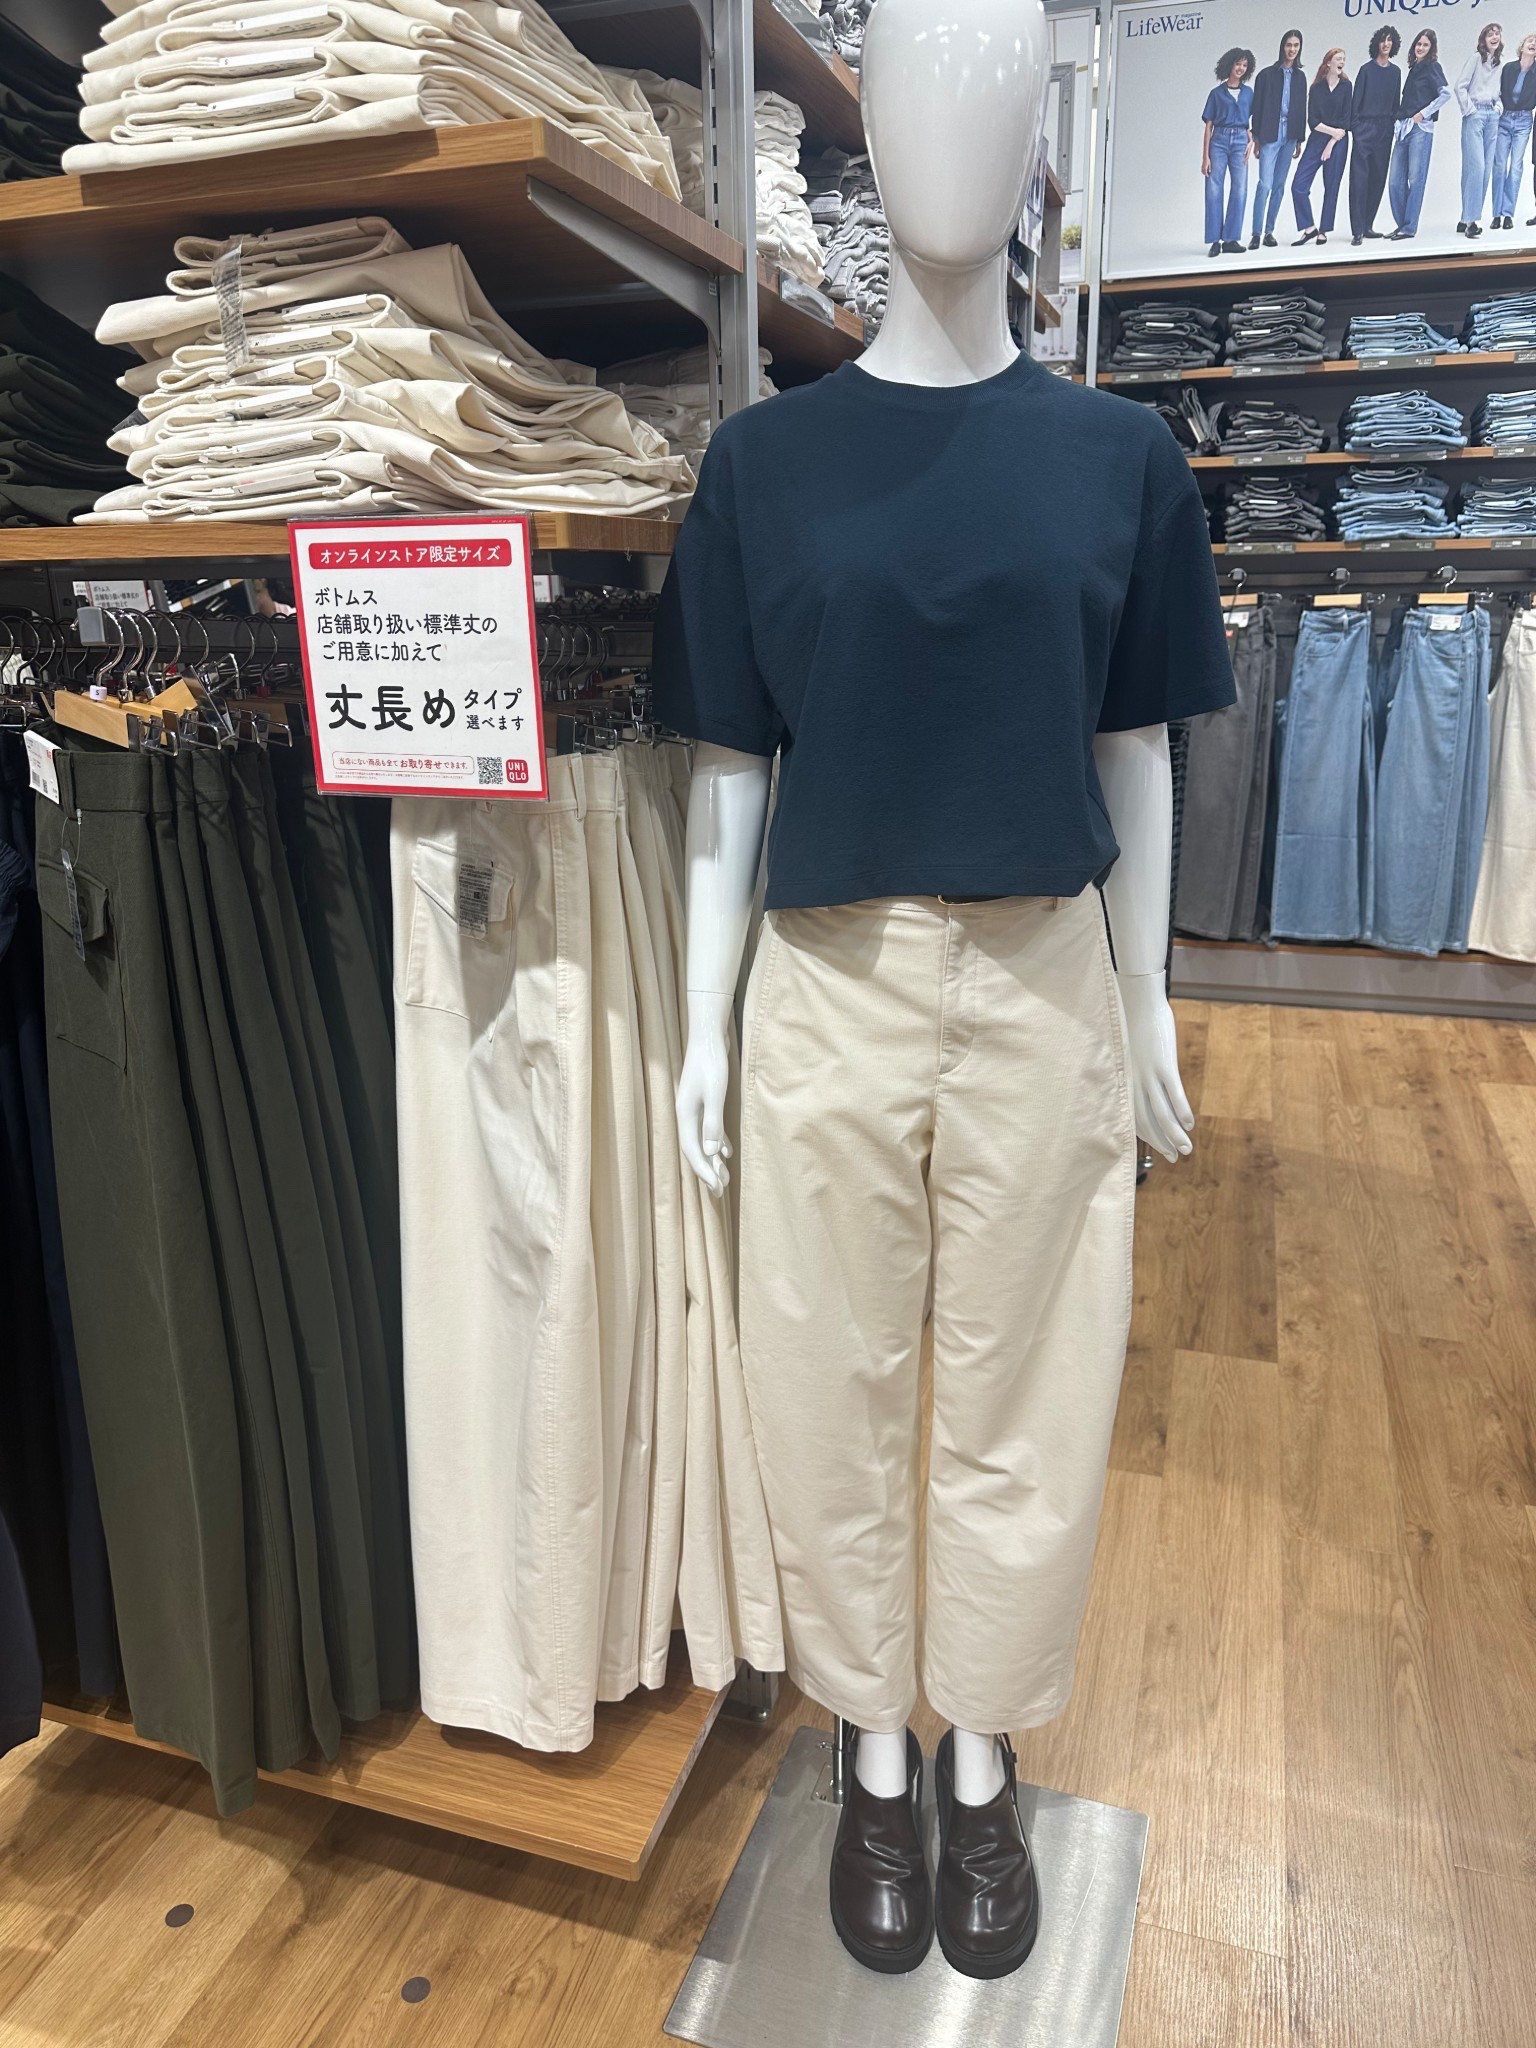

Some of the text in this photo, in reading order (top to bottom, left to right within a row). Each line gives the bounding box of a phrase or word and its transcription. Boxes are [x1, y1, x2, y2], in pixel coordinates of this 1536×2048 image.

[1126, 15, 1204, 38] LifeWear
[320, 545, 500, 564] オンラインストア限定サイズ
[315, 587, 378, 606] ボトムス
[317, 613, 498, 635] 店舗取り扱い標準丈の
[322, 641, 442, 662] ご用意に加えて
[325, 683, 523, 732] 丈長め タイプ
[466, 714, 524, 731] 選べます
[507, 761, 525, 771] UNI
[508, 772, 526, 782] QLO
